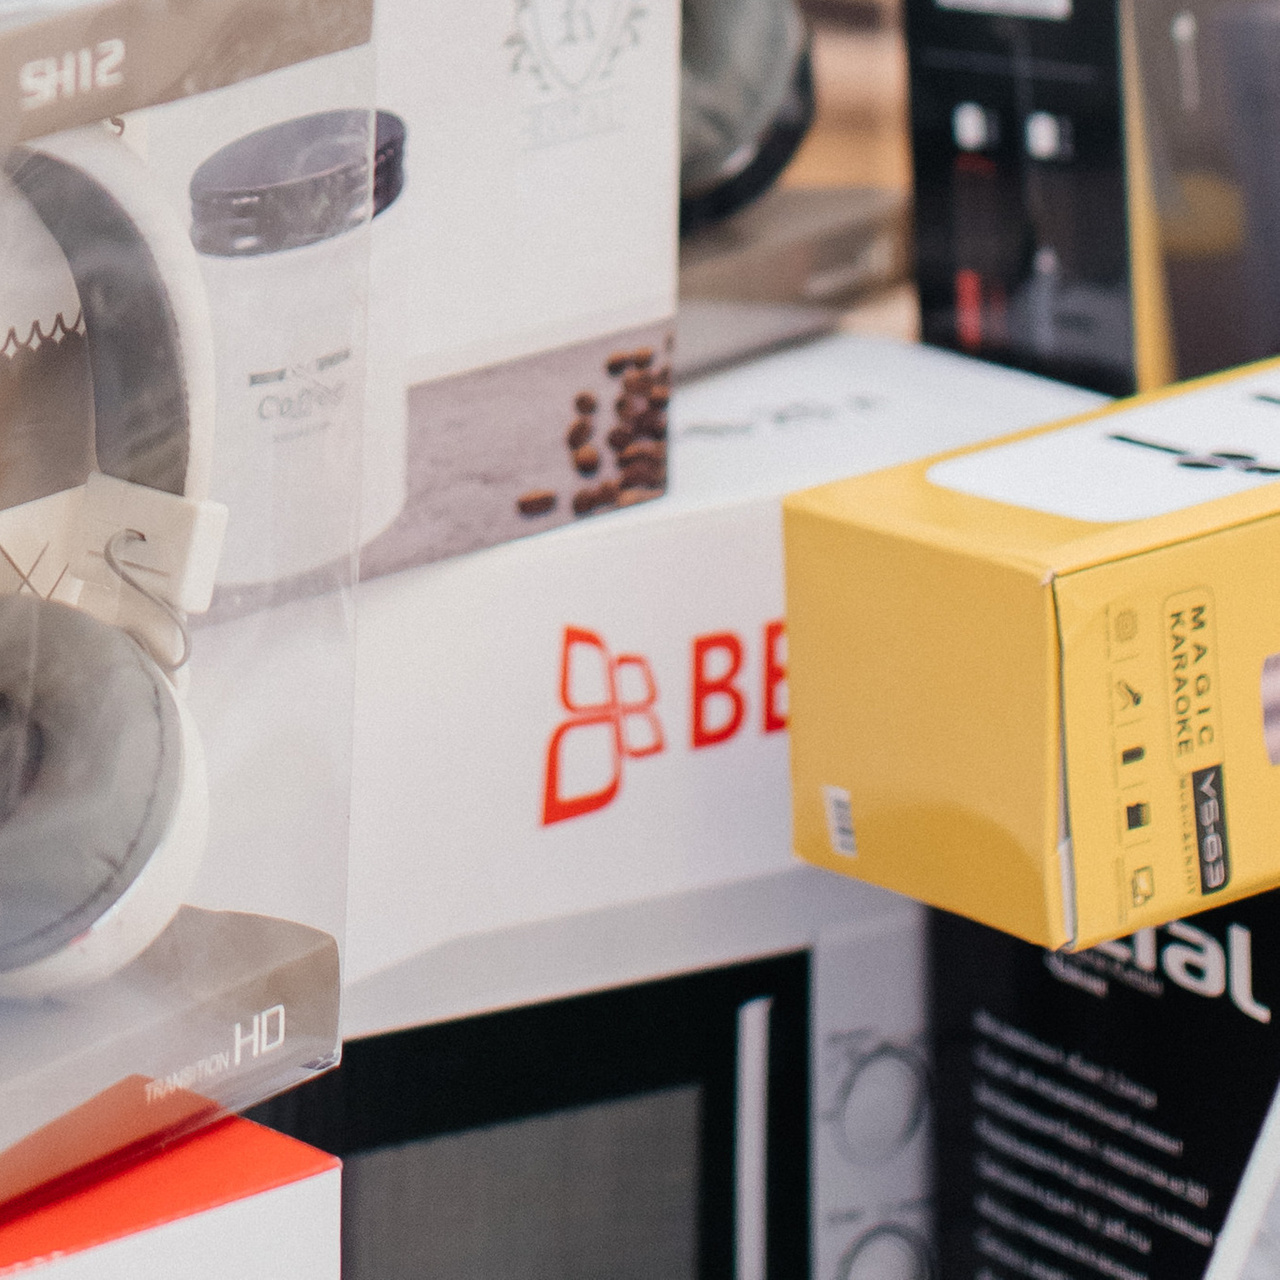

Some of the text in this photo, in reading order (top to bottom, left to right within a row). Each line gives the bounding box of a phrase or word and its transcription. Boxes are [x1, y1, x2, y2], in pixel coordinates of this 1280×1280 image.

[1169, 609, 1194, 758] KARAOKE
[1190, 603, 1215, 747] MAGIC
[234, 1002, 286, 1068] HD
